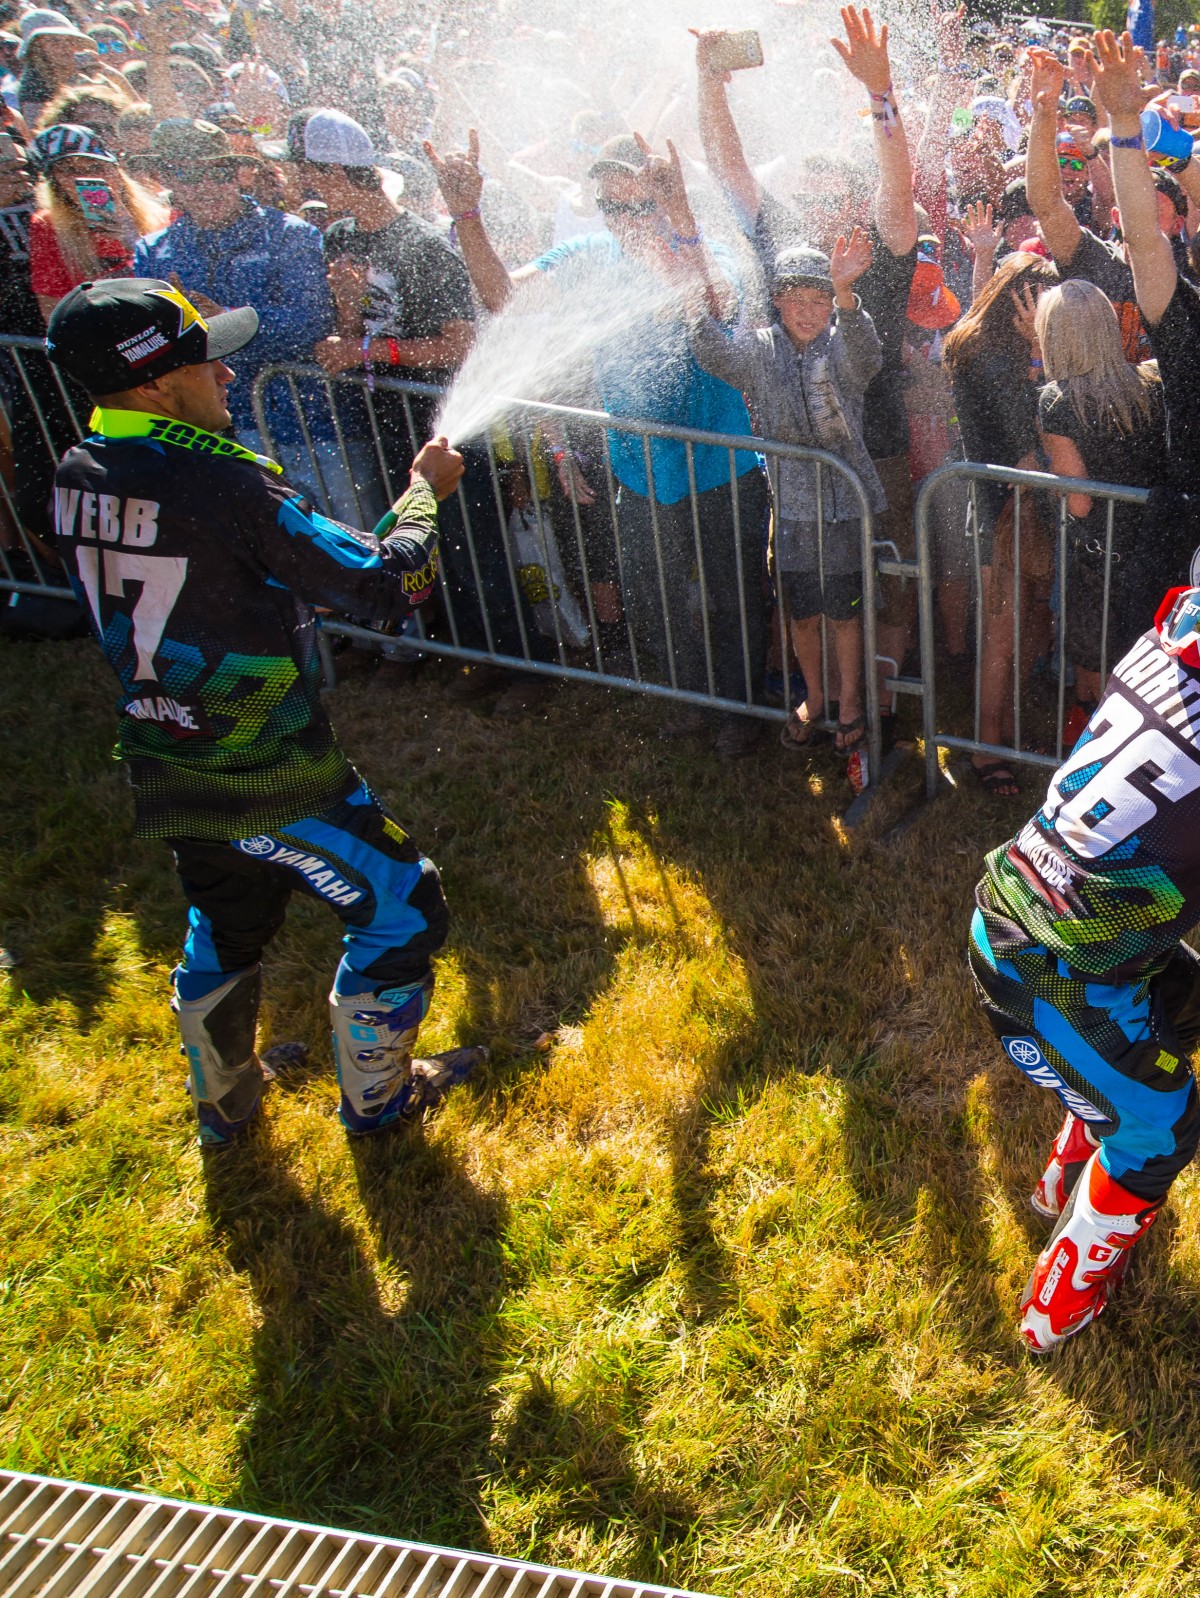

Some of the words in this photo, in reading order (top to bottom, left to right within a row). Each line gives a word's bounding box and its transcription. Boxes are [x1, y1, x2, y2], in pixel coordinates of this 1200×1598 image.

[116, 326, 156, 351] DUNLOP
[121, 332, 169, 364] YAMALUBE
[148, 419, 249, 457] 100%
[54, 486, 160, 547] WEBB
[76, 545, 188, 682] 17
[267, 847, 362, 906] YAMAHA
[1154, 1049, 1180, 1074] THOR
